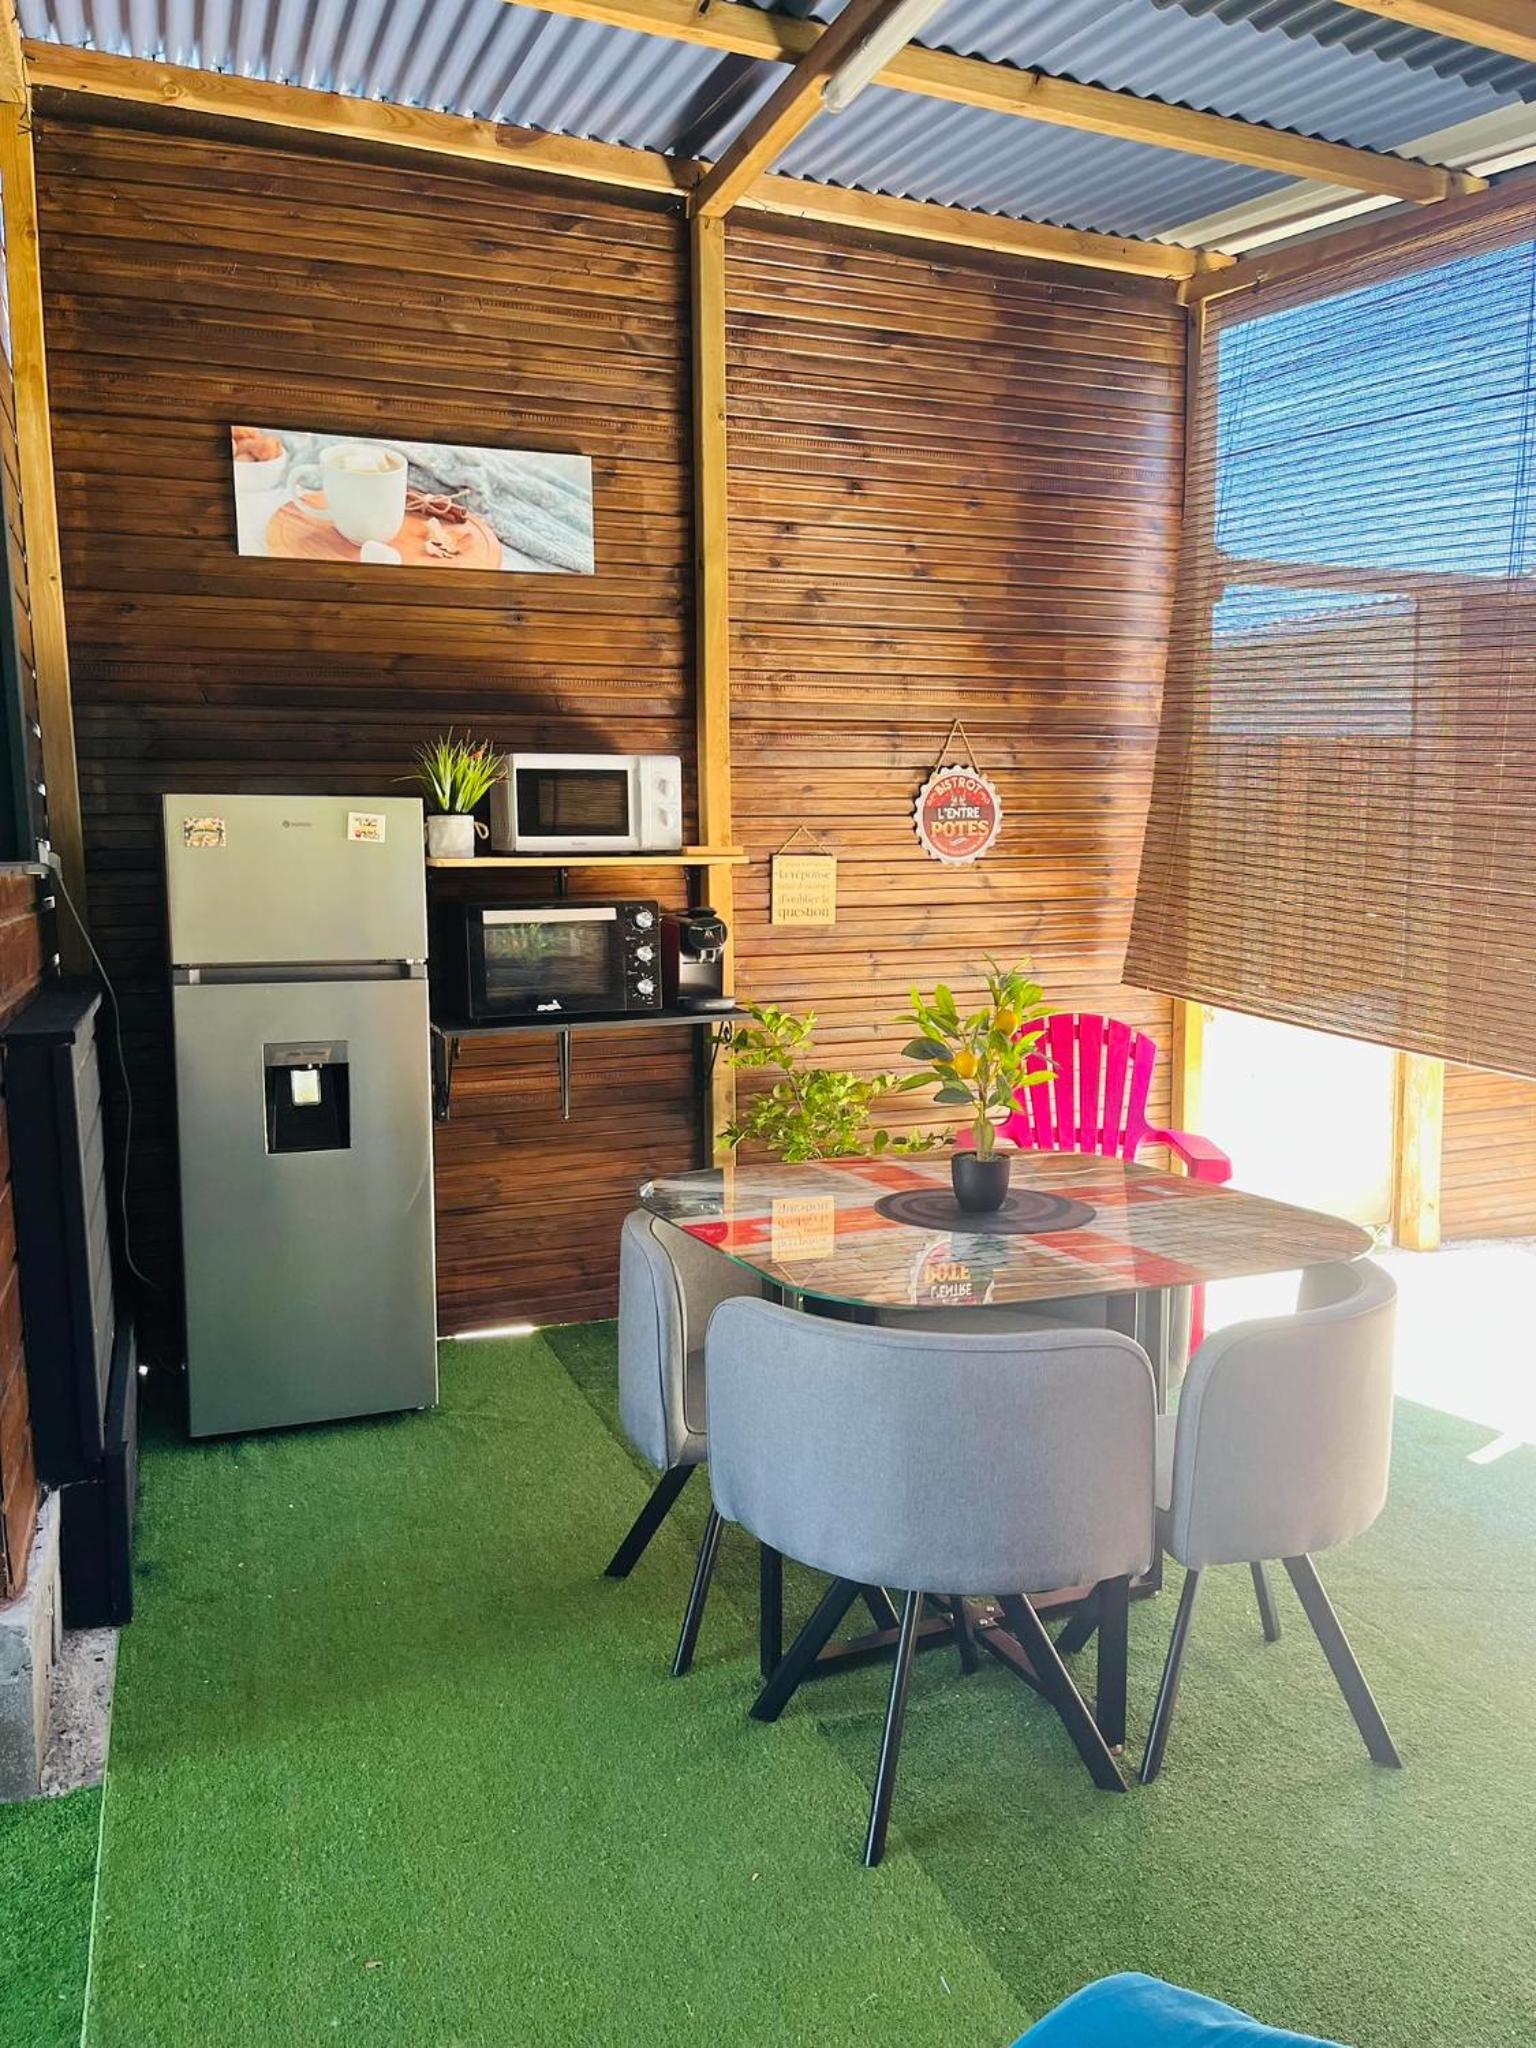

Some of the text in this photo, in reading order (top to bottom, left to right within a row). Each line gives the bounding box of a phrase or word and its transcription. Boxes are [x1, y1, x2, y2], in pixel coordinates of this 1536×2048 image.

[934, 776, 983, 796] BISTROT
[937, 806, 980, 820] L'ENTRE
[930, 819, 990, 837] POTES
[778, 907, 830, 920] question
